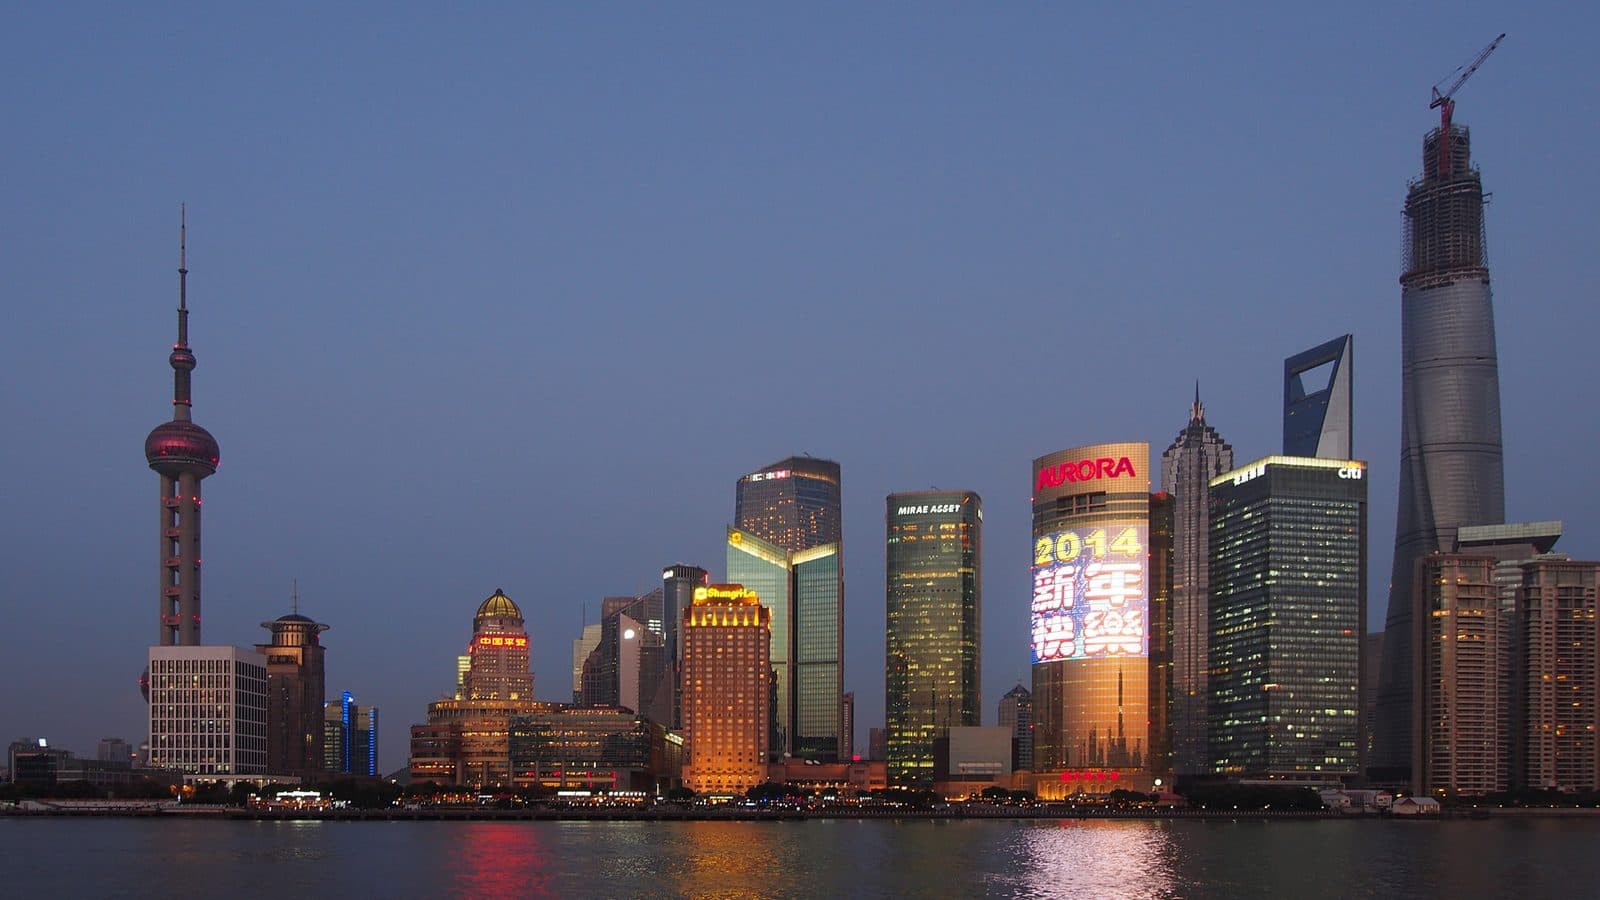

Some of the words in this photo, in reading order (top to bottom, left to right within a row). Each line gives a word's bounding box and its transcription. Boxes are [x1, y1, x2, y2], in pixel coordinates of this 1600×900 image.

[1037, 457, 1136, 491] AURORA
[898, 506, 928, 515] MIRAE
[930, 505, 960, 513] ASSET
[1035, 528, 1142, 567] 2014
[708, 586, 756, 600] Shangri-La
[1033, 563, 1143, 612] 新年
[480, 637, 527, 647] 中国平安
[1032, 611, 1143, 660] 快樂
